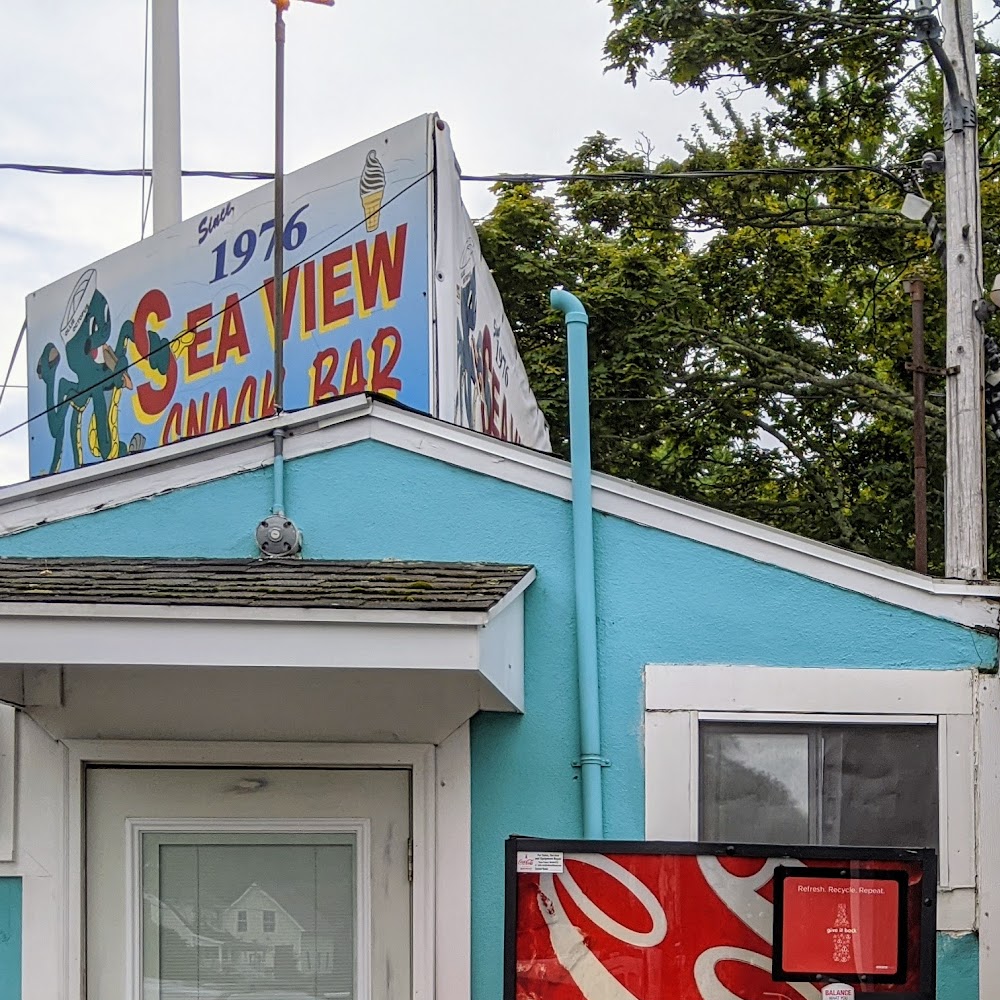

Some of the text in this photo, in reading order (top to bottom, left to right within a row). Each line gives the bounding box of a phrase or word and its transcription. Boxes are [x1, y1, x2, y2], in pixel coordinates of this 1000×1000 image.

[209, 203, 310, 285] 1976
[313, 326, 402, 405] BAR
[798, 885, 826, 893] Refresh.
[828, 886, 858, 894] Recycle.
